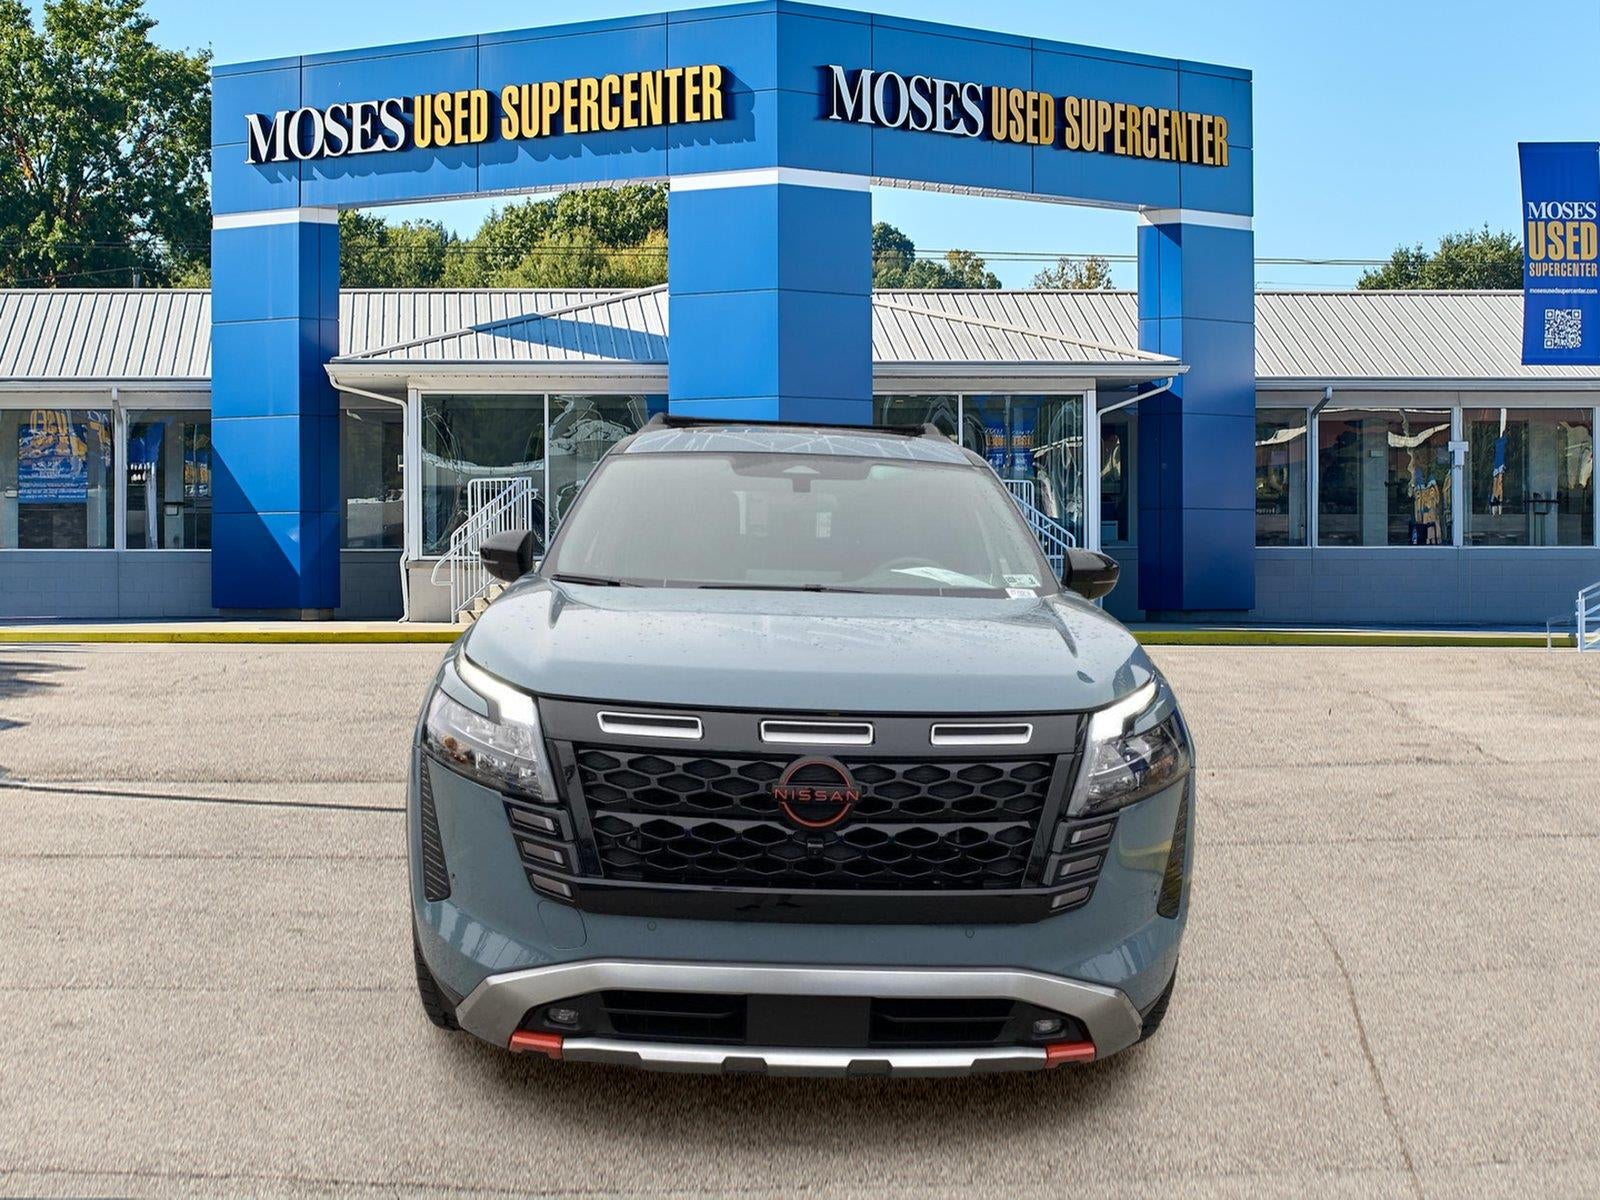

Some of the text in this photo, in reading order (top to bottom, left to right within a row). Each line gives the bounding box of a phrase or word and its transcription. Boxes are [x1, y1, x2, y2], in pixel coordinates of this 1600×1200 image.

[244, 63, 724, 164] MOSES USED SUPERCENTER
[828, 64, 1230, 167] MOSES USED SUPERCENTER
[1529, 202, 1597, 219] MOSES
[1529, 222, 1598, 261] USED
[1530, 263, 1598, 277] SUPERCENTER
[774, 789, 859, 801] NISSAN
